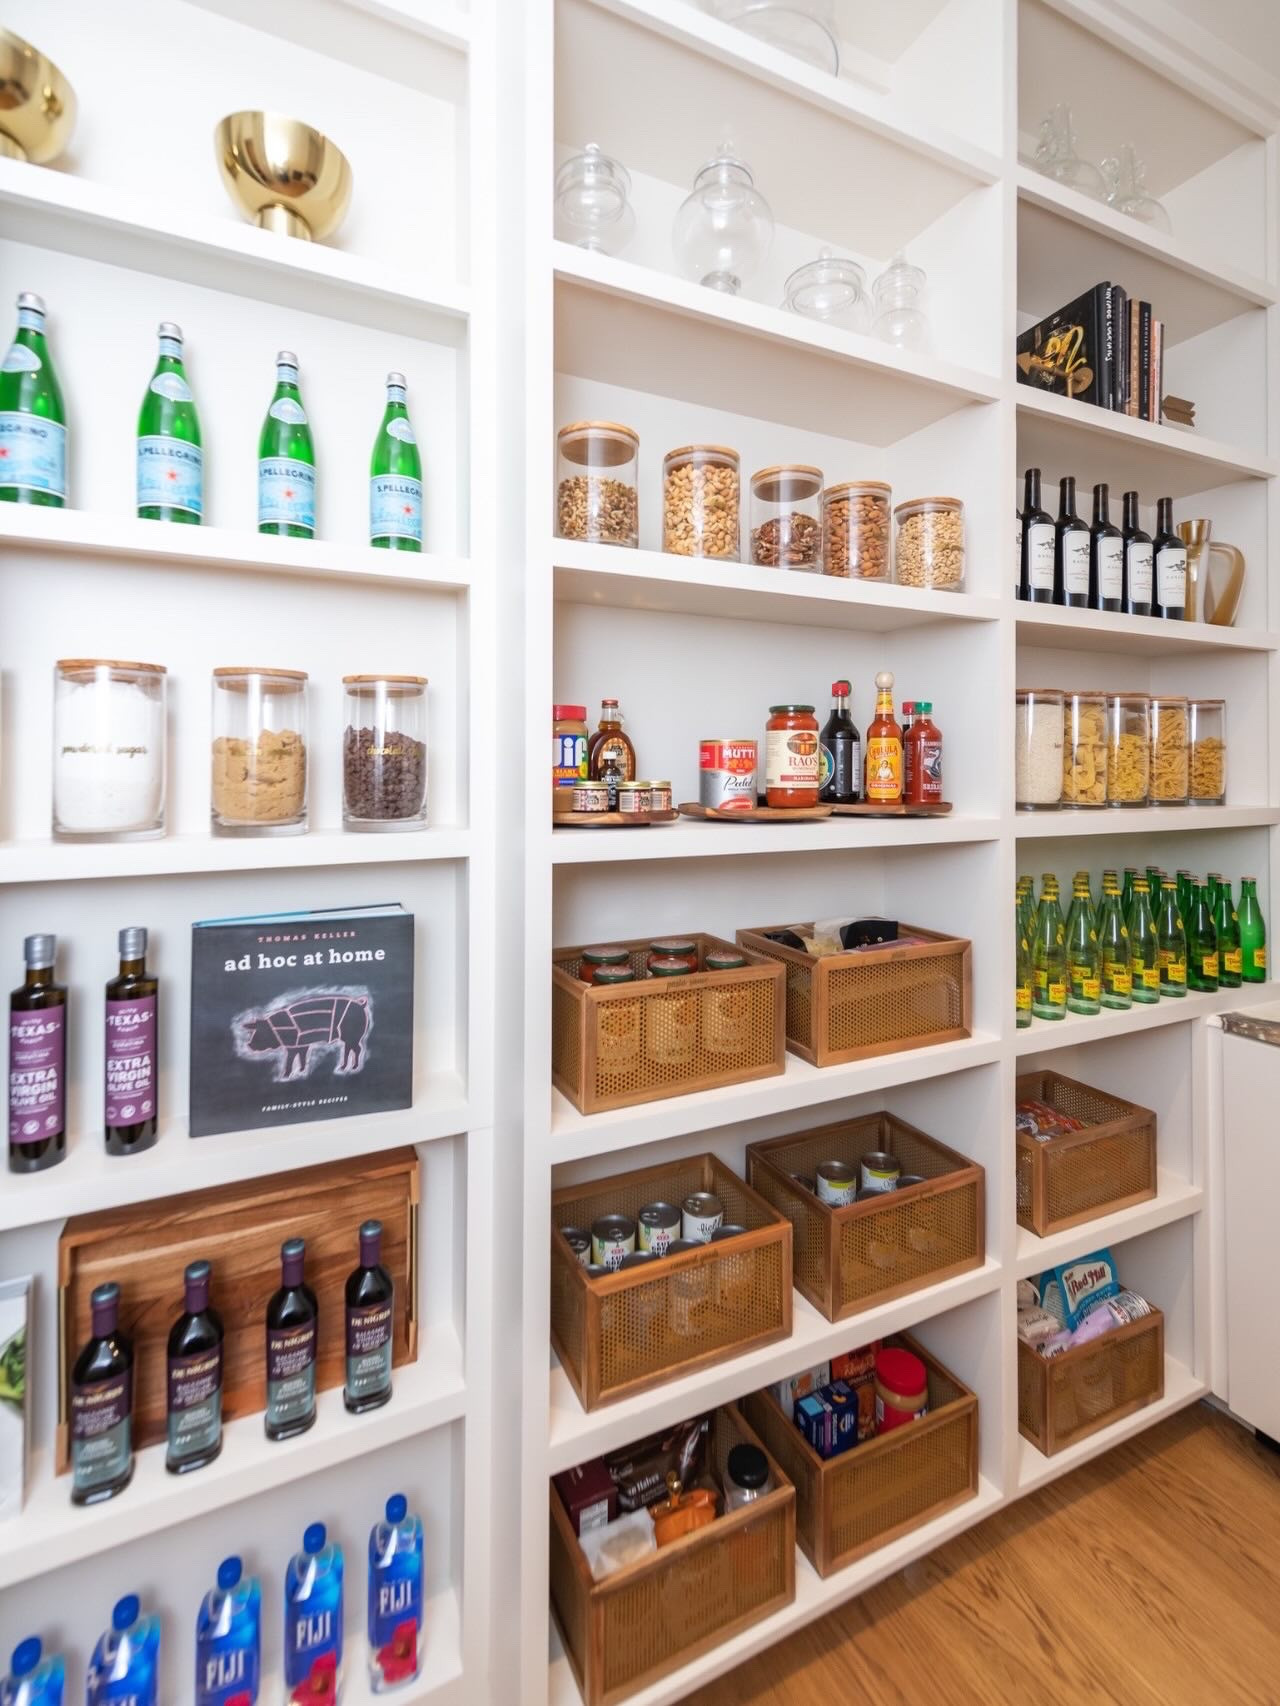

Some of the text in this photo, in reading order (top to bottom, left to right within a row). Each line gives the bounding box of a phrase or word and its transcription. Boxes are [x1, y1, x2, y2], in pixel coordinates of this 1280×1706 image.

[721, 749, 755, 759] MUTTI
[256, 931, 357, 943] THOMAS KELLER
[223, 948, 386, 972] ad hoc at home
[107, 1055, 152, 1072] EXTRA
[261, 1099, 316, 1113] FAMILY-STYLE
[379, 1580, 412, 1616] FIJI
[296, 1611, 331, 1649] FIJI
[206, 1649, 245, 1691] FIJI
